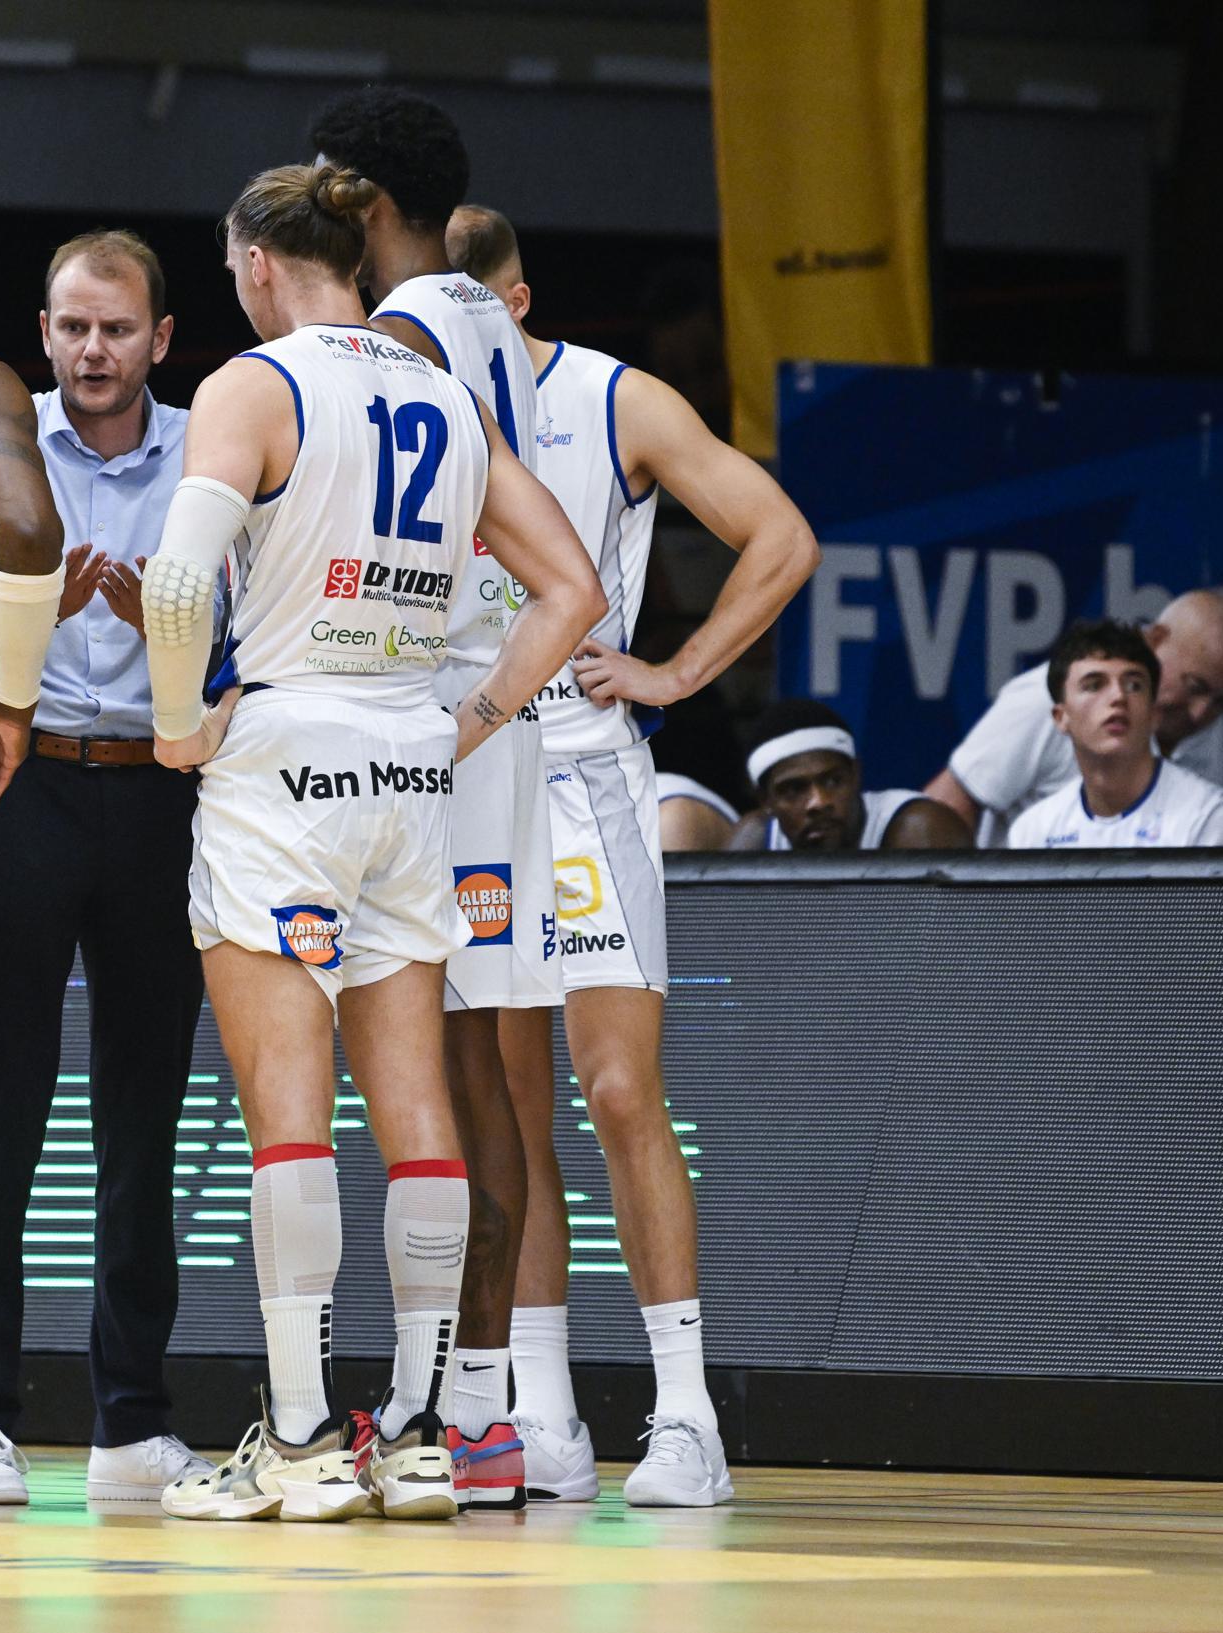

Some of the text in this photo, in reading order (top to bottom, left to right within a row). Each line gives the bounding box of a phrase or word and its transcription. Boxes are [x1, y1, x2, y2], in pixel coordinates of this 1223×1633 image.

[366, 394, 449, 544] 12
[392, 567, 453, 600] VIDEO
[311, 620, 376, 646] Green
[808, 542, 1067, 702] FVP
[305, 656, 377, 673] MARKETING
[279, 757, 454, 802] Van Mossel
